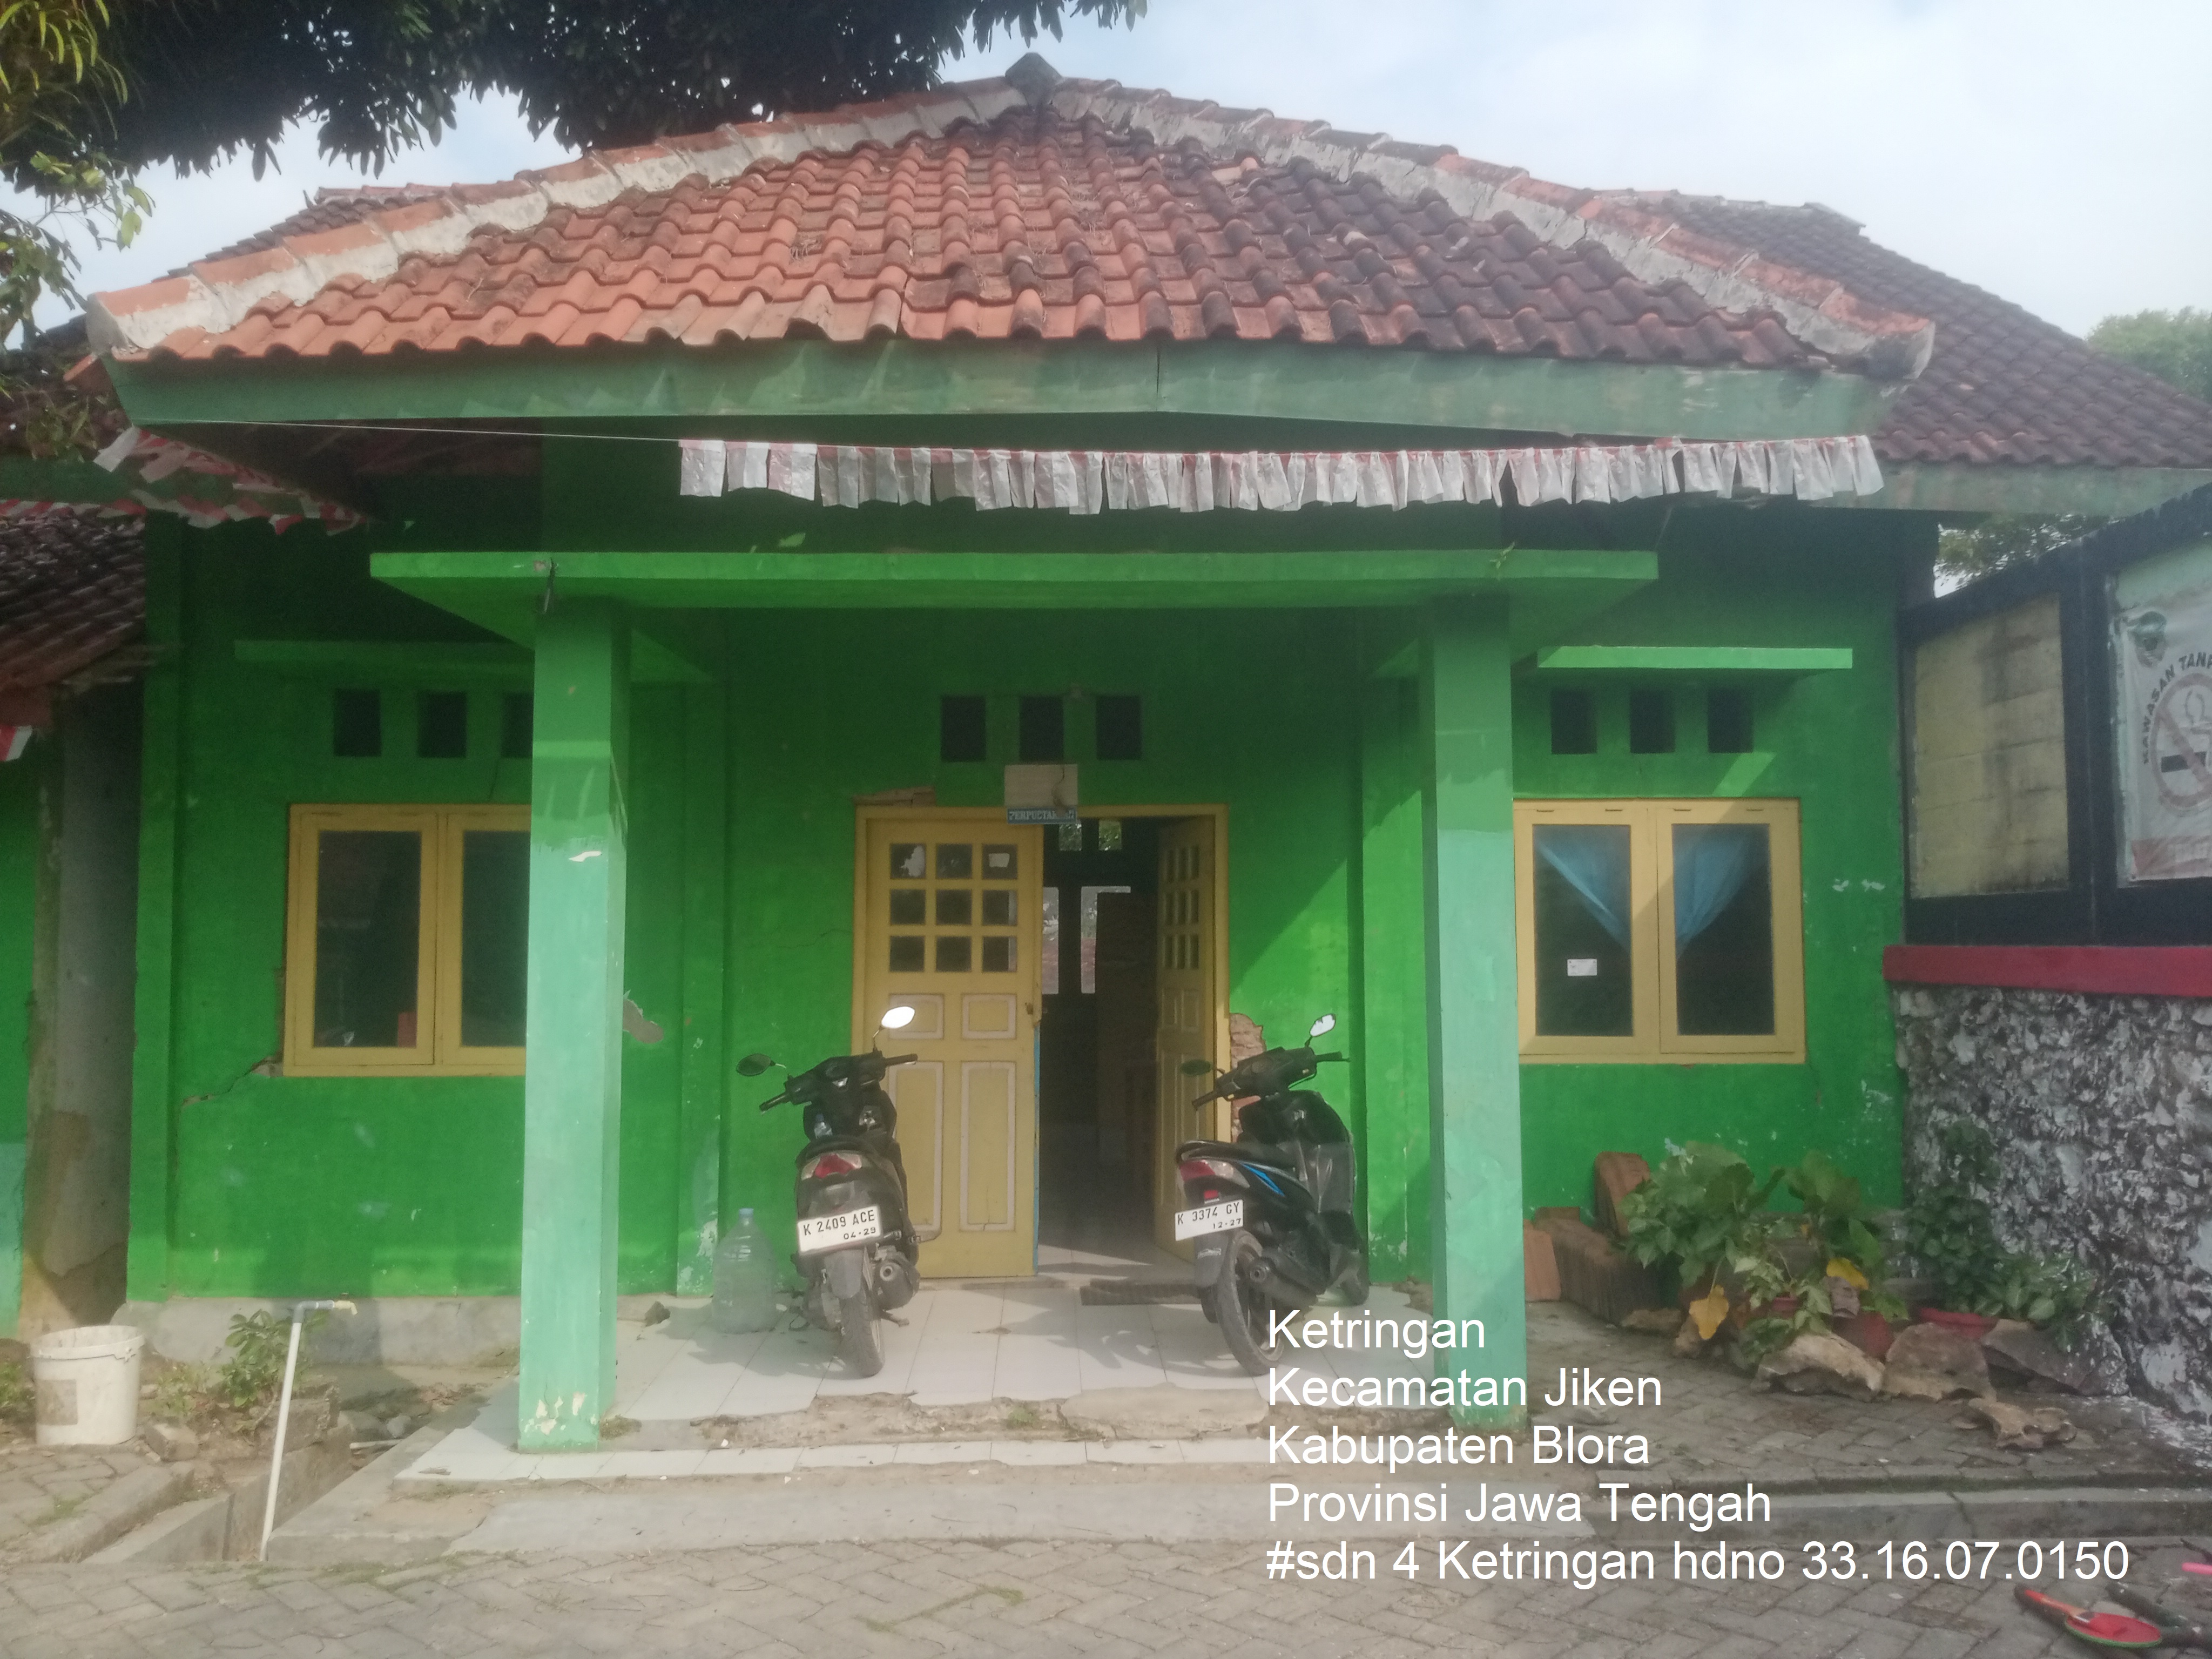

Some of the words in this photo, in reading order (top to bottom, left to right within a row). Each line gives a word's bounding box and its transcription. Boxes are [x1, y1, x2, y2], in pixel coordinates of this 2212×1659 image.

[803, 1223, 811, 1236] K
[817, 1216, 846, 1232] 2409
[853, 1209, 875, 1225] ACE
[1178, 1213, 1184, 1225] K
[1192, 1206, 1218, 1222] 3374
[1226, 1202, 1240, 1215] GY
